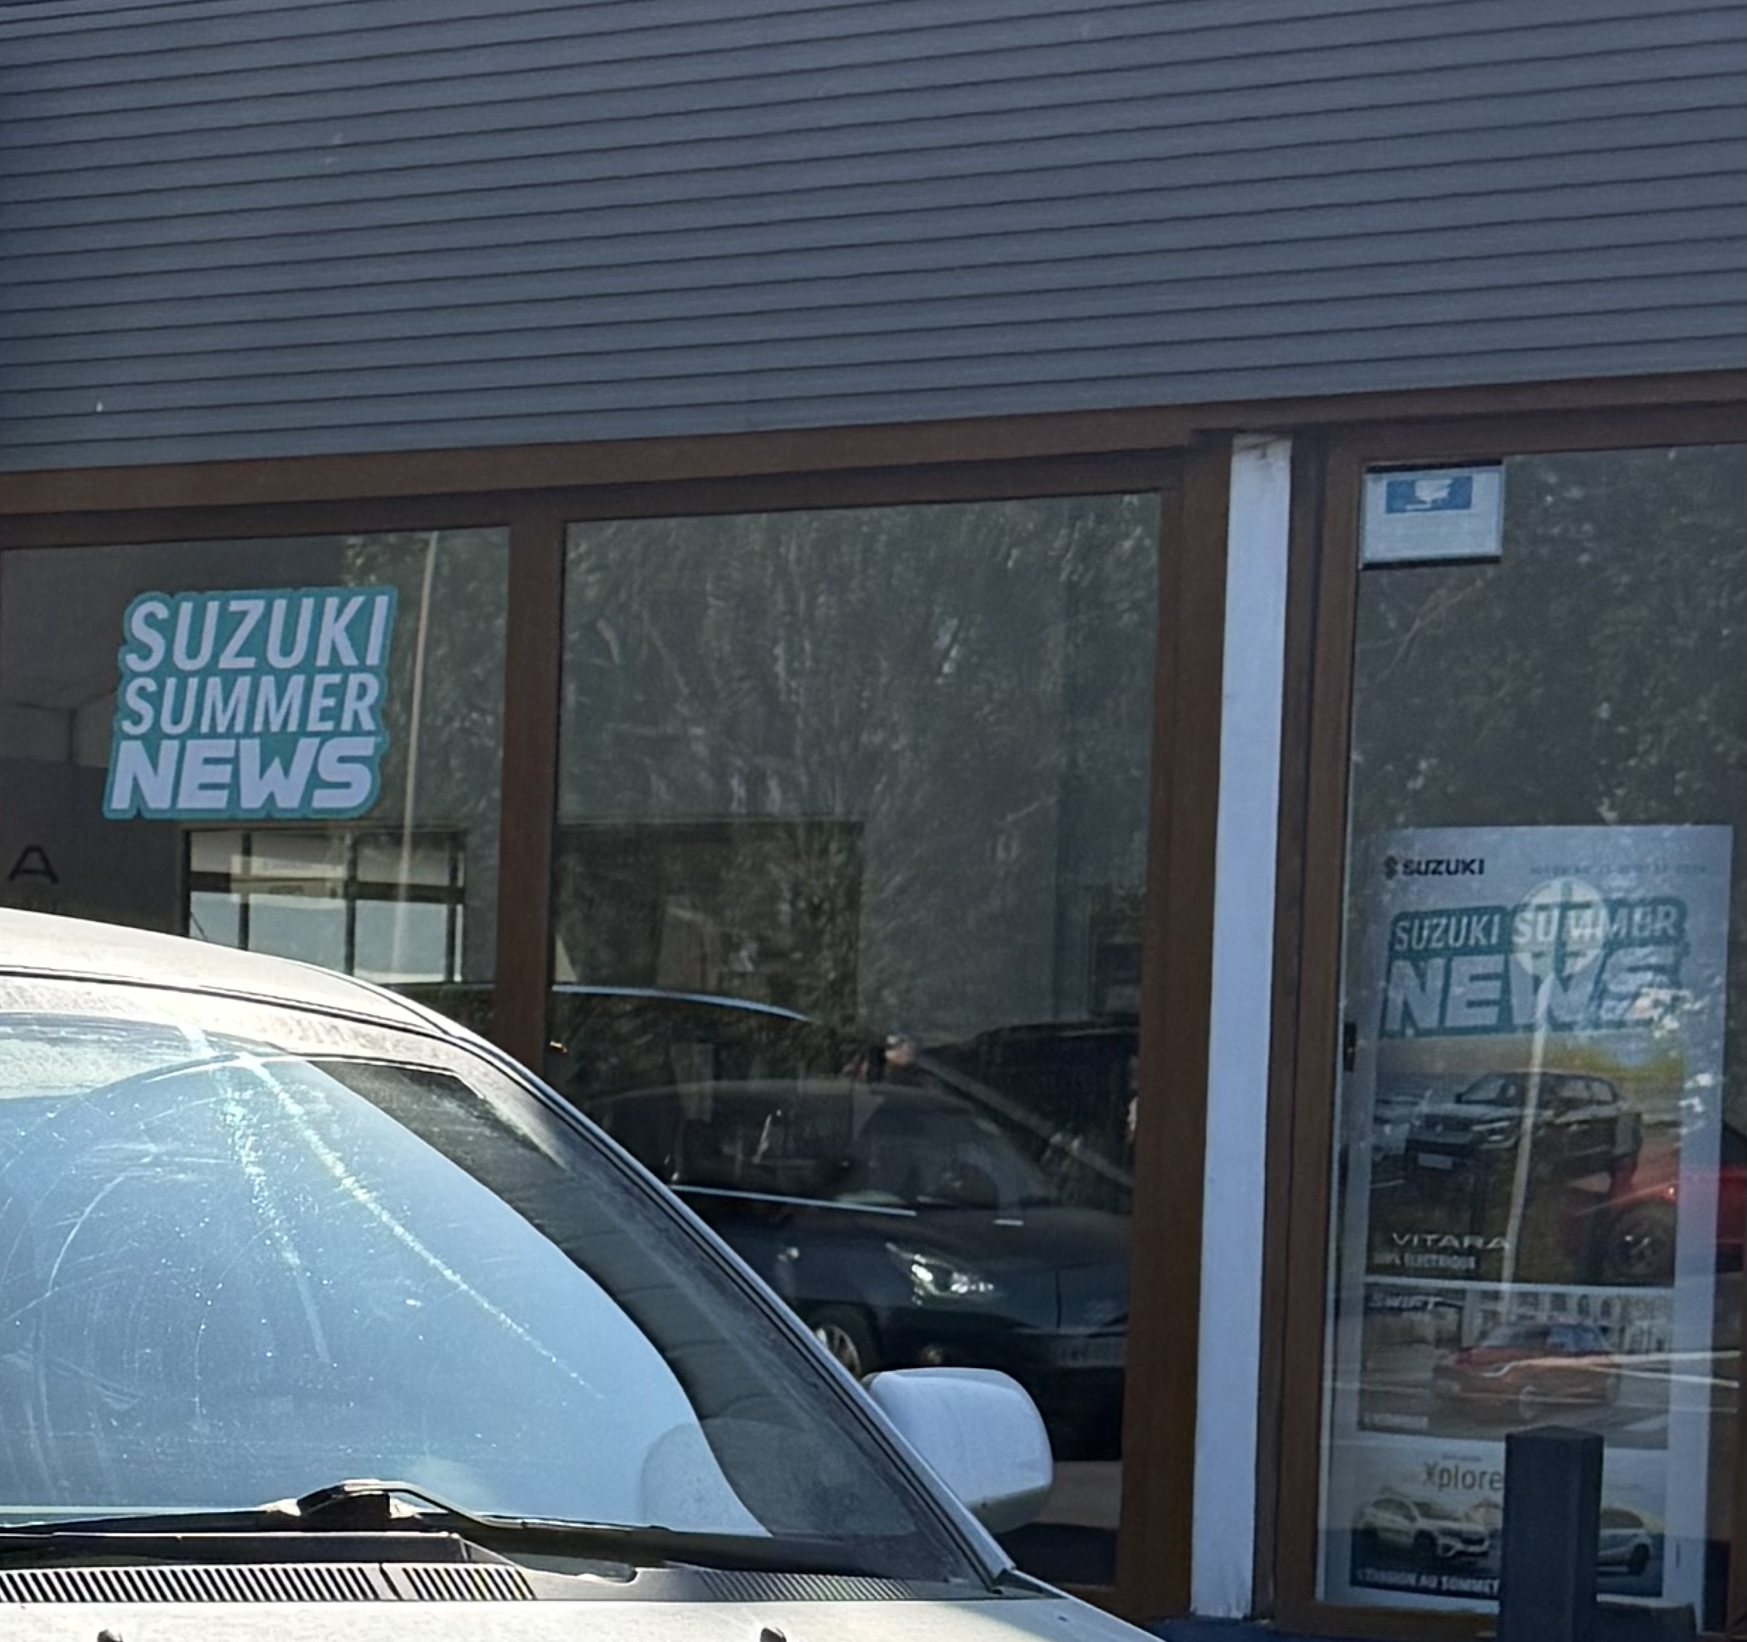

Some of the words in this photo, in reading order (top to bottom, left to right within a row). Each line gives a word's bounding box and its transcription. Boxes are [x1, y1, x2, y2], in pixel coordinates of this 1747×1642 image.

[124, 595, 390, 673] SUZUKI
[120, 672, 382, 736] SUMMER
[110, 738, 377, 811] NEWS
[1402, 858, 1484, 877] SUZUKI
[1394, 914, 1500, 952] SUZUKI
[1512, 904, 1679, 946] SUMMER
[1385, 946, 1677, 1032] NEWS
[1392, 1232, 1509, 1249] VITARA
